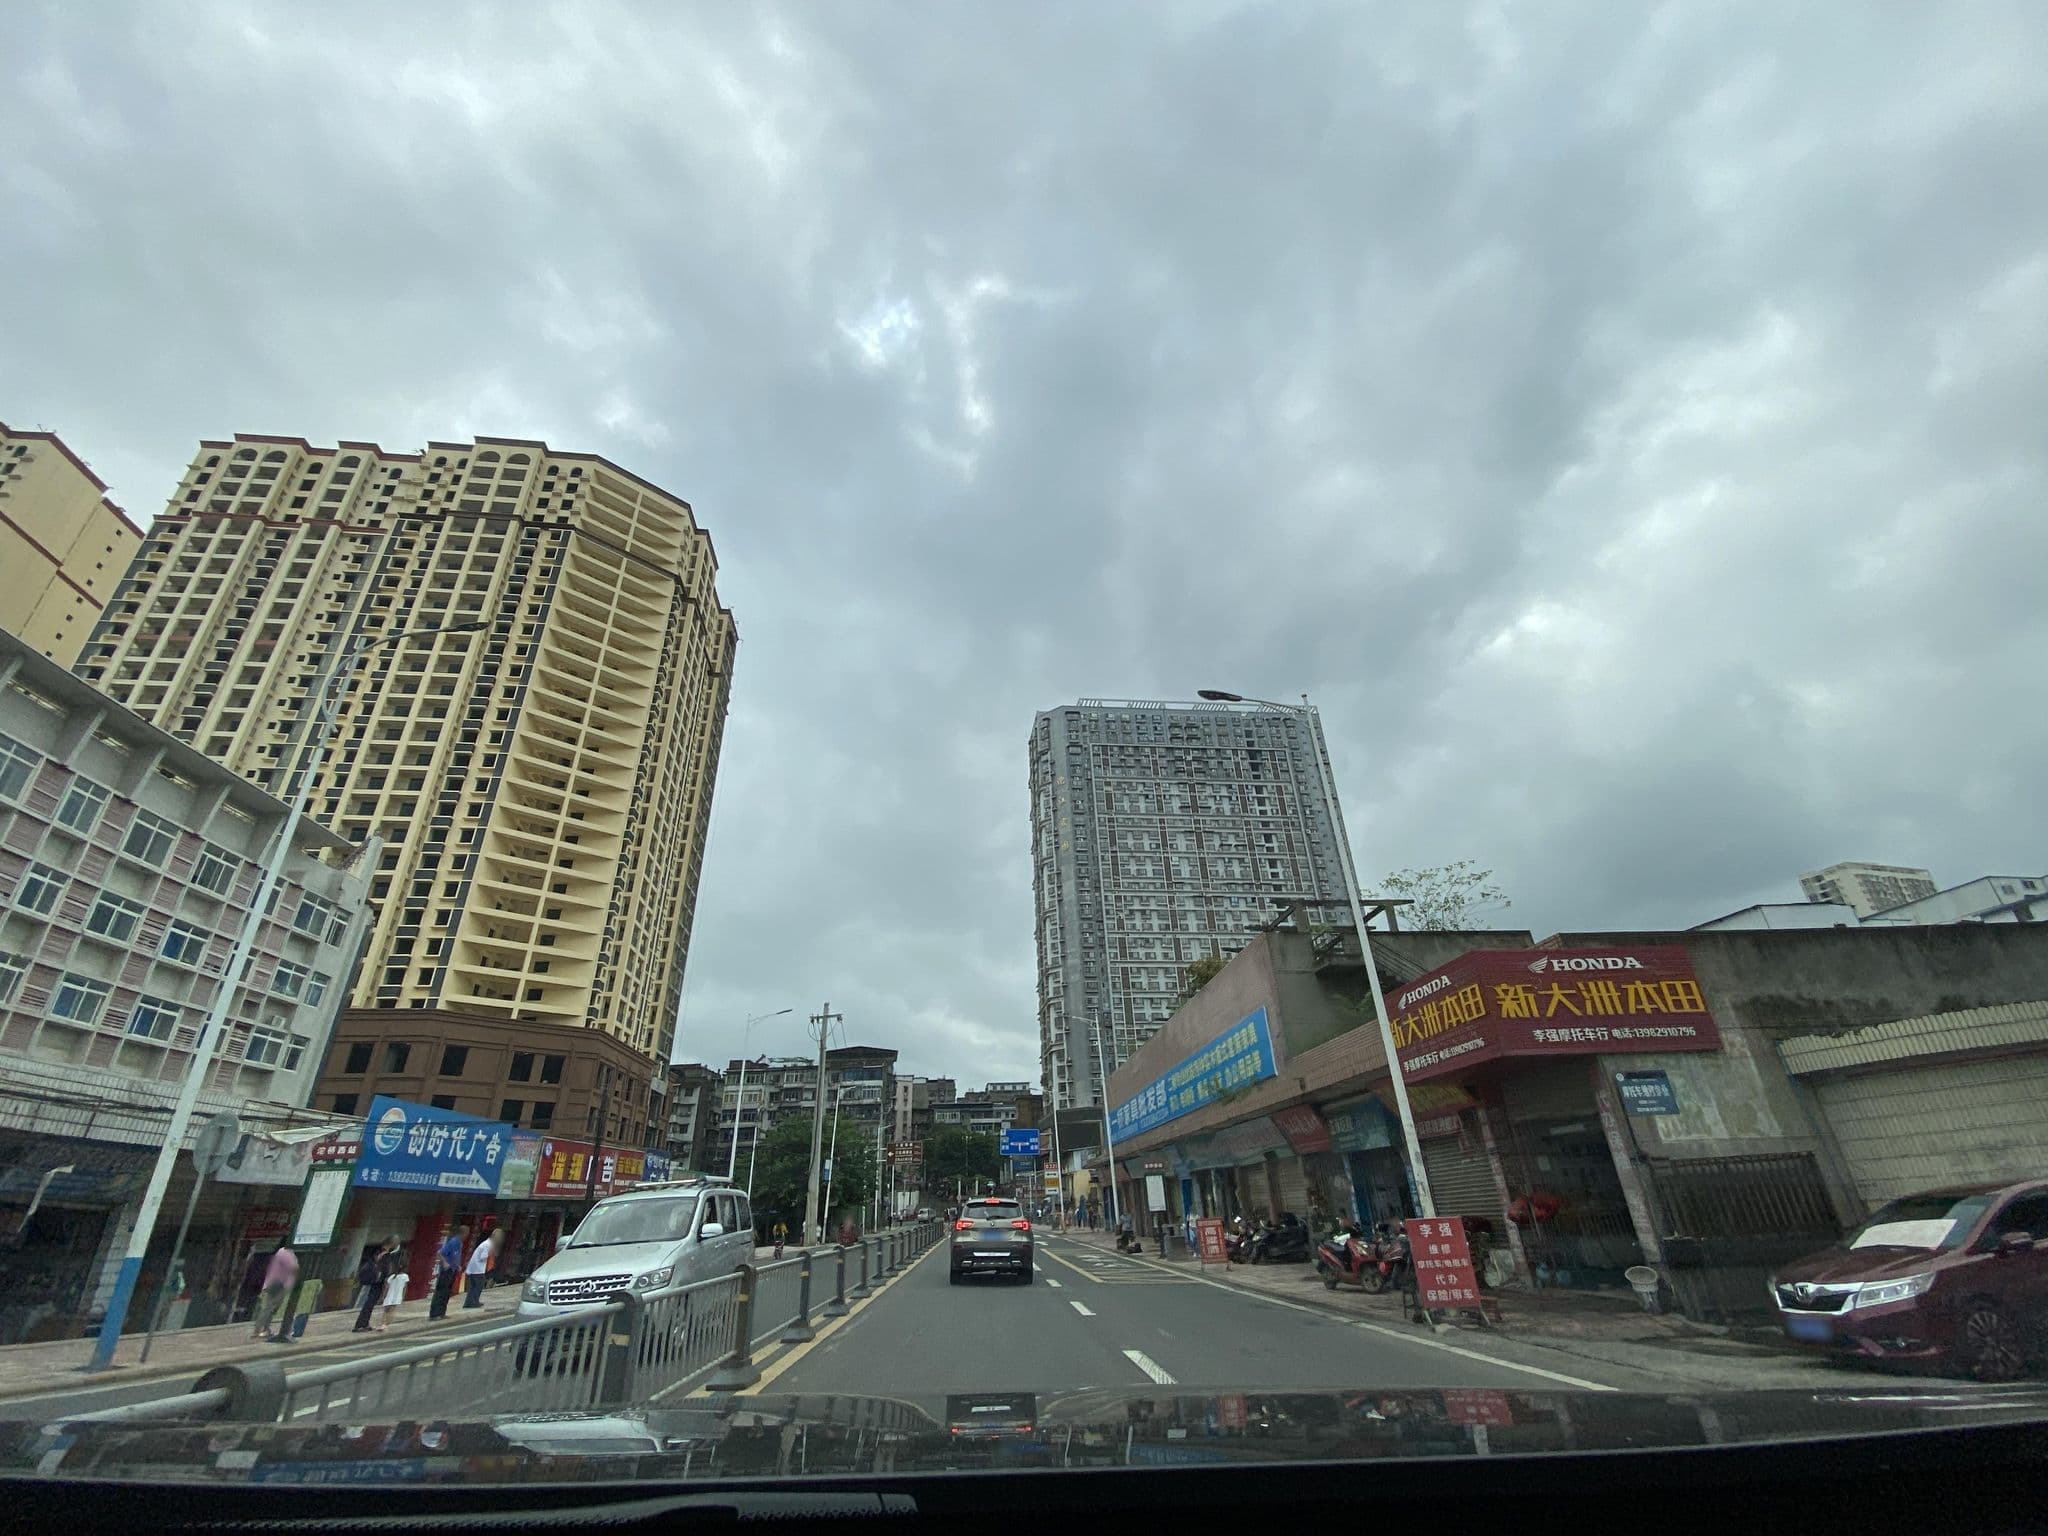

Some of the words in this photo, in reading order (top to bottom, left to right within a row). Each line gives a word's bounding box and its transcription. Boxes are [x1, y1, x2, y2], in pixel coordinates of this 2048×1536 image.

[1551, 956, 1644, 972] HONDA
[1406, 974, 1453, 1004] HONDA
[1494, 980, 1707, 1018] 新大洲本田
[1532, 1026, 1610, 1043] 李强摩托车行
[408, 1117, 501, 1166] 创时代广告
[1419, 1222, 1453, 1238] 李强
[1428, 1243, 1452, 1255] 维修
[1435, 1273, 1458, 1285] 代办
